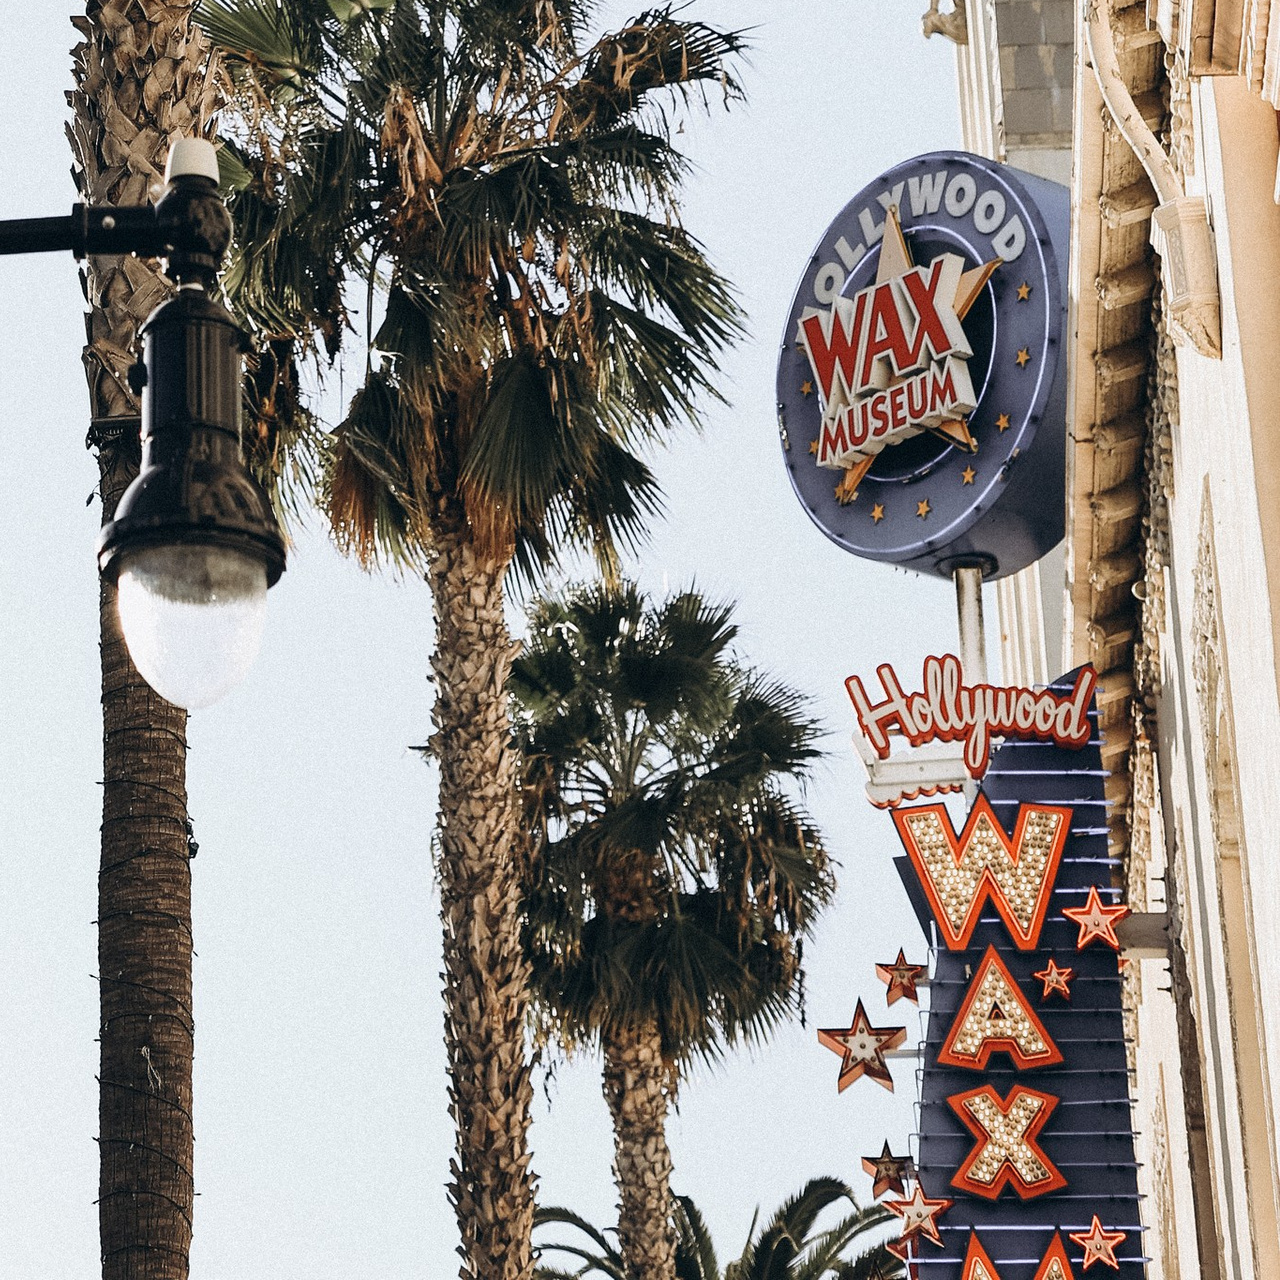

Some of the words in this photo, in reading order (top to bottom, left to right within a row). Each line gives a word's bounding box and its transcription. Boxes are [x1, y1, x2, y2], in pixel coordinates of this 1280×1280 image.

[813, 170, 1027, 305] OLLYWOOD
[799, 258, 954, 405] WAX
[820, 360, 959, 464] MUSEUM
[845, 654, 1098, 780] Hollywood
[891, 793, 1073, 1200] WAX
